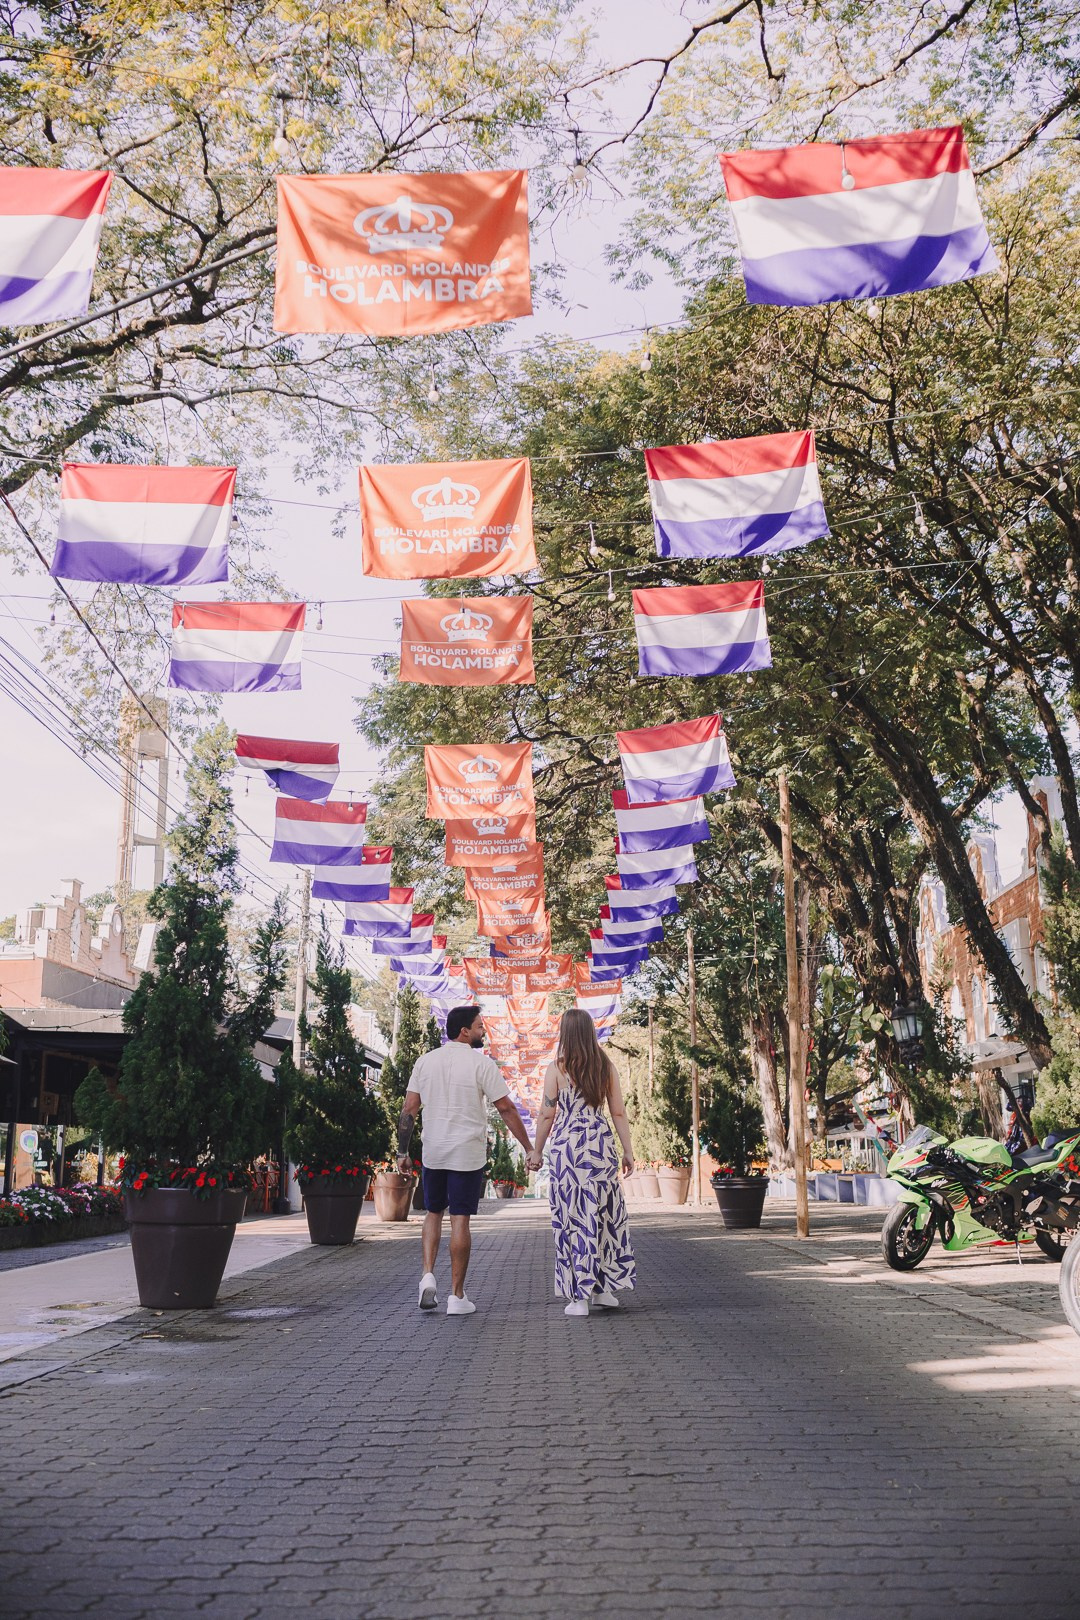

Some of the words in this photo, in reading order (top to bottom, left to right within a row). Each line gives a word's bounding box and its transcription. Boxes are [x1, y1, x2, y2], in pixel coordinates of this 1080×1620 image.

[296, 260, 407, 281] BOULEVARD
[304, 275, 505, 305] HOLAMBRA
[374, 527, 449, 538] BOULEVARD
[452, 523, 520, 537] HOLANDÊS
[379, 537, 517, 554] HOLAMBRA
[410, 645, 468, 656] BOULEVARD
[414, 654, 519, 669] HOLAMBRA
[433, 785, 483, 794] BOULEVARD
[437, 790, 523, 805] HOLAMBRA
[451, 838, 492, 846] BOULEVARD
[454, 843, 528, 855] HOLAMBRA
[473, 879, 536, 890] HOLAMBRA
[484, 917, 539, 927] HOLAMBRA
[496, 959, 540, 967] HOLAMBRA
[580, 982, 618, 991] HOLAMBRA
